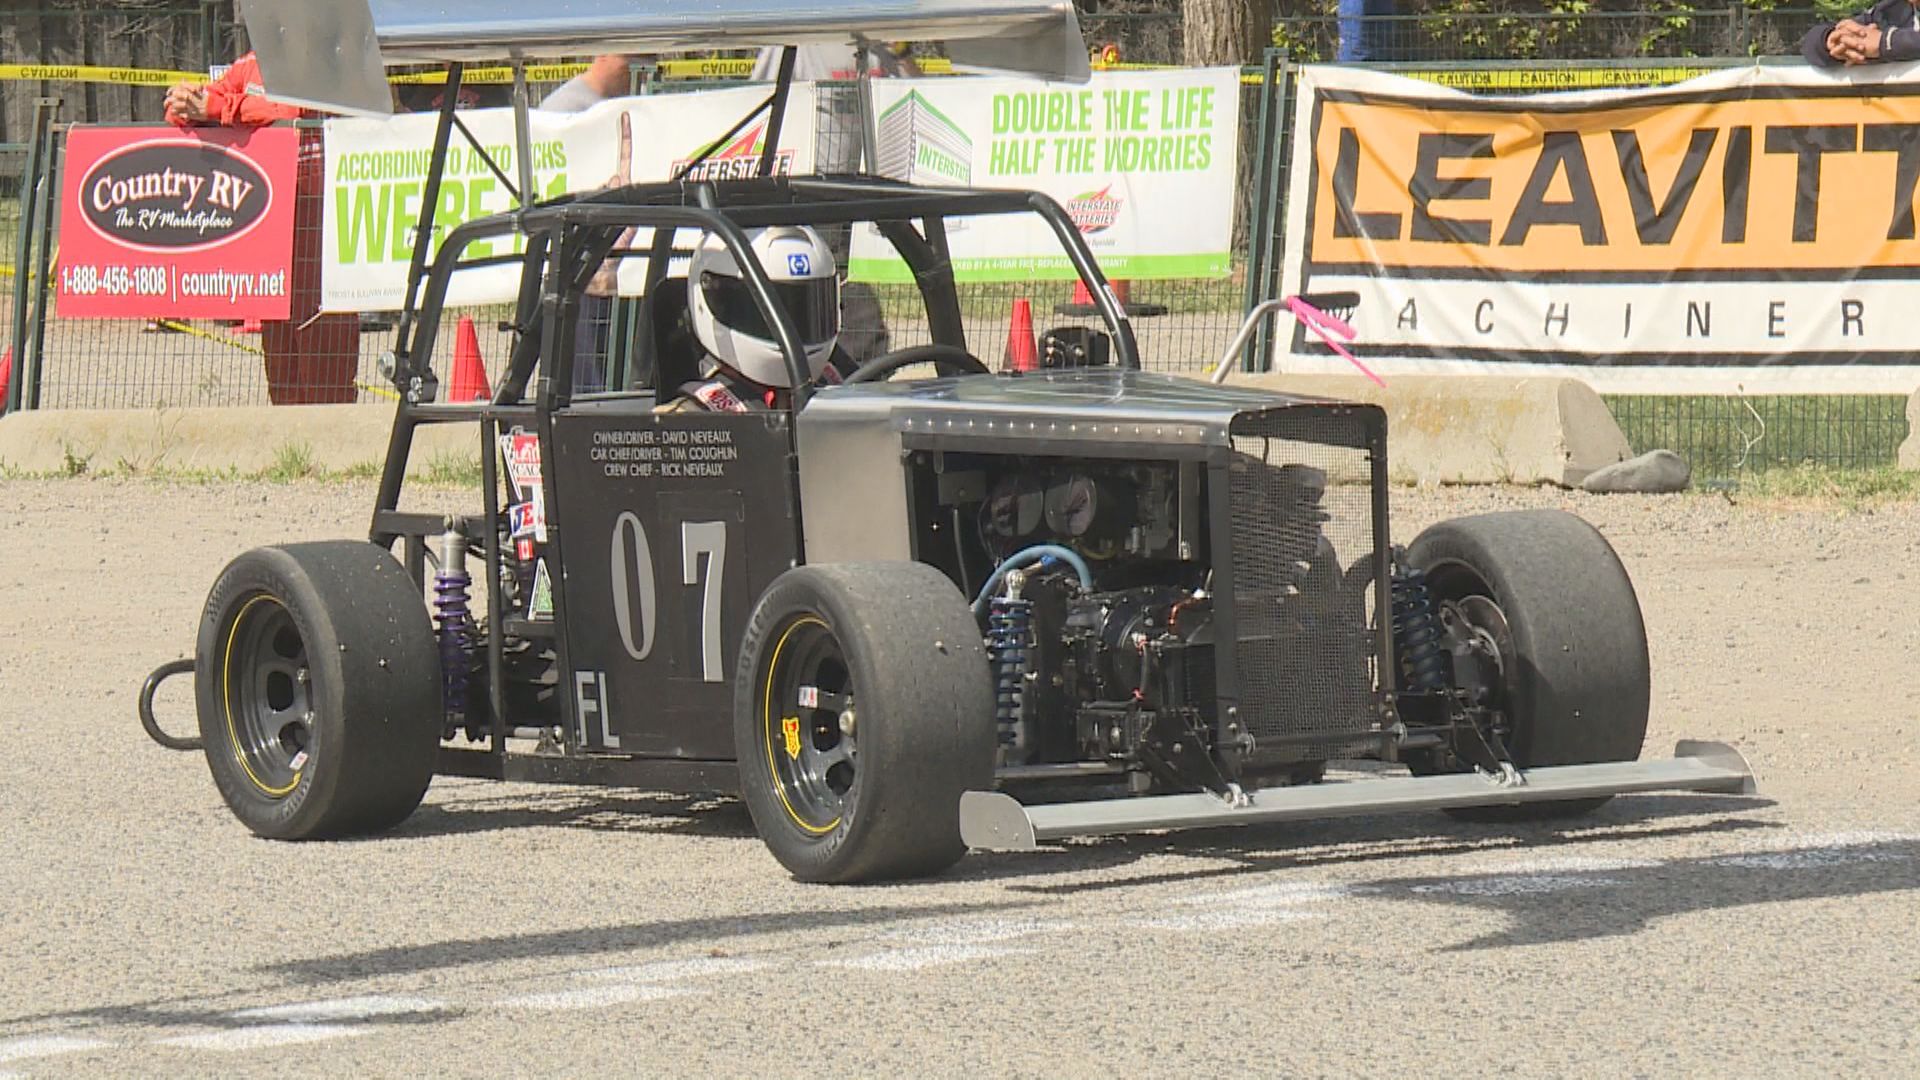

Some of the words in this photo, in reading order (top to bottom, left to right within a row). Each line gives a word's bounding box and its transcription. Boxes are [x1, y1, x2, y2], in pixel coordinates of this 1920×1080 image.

[1437, 70, 1491, 84] CAUTION
[1520, 70, 1576, 84] CAUTION
[1605, 69, 1660, 82] CAUTION
[992, 90, 1093, 134] DOUBLE
[1102, 89, 1151, 132] THE
[1160, 87, 1215, 130] LIFE
[988, 139, 1046, 176] HALF
[1053, 136, 1100, 175] THE
[1103, 133, 1212, 174] WORRIES
[92, 166, 206, 212] Country
[207, 169, 254, 213] RV
[1332, 123, 1920, 247] LEAVITT
[115, 206, 135, 228] The
[138, 207, 159, 231] RV
[159, 208, 234, 235] Marketplace
[1071, 213, 1115, 225] ATTERIES
[61, 265, 168, 296] 1-888-456-1808
[181, 268, 286, 305] countryrv.net
[593, 430, 655, 445] OWNER/DRIVER
[662, 430, 688, 444] DAVID
[690, 430, 732, 444] NEVEAUX
[591, 447, 607, 461] CAR
[608, 447, 663, 461] CHIEF/DRIVER
[671, 447, 686, 461] TIM
[688, 447, 738, 461] COUGHLIN
[604, 463, 627, 477] CREW
[630, 463, 653, 477] CHIEF
[661, 463, 681, 477] RICK
[683, 463, 725, 477] NEVEAUX
[575, 670, 621, 748] FL
